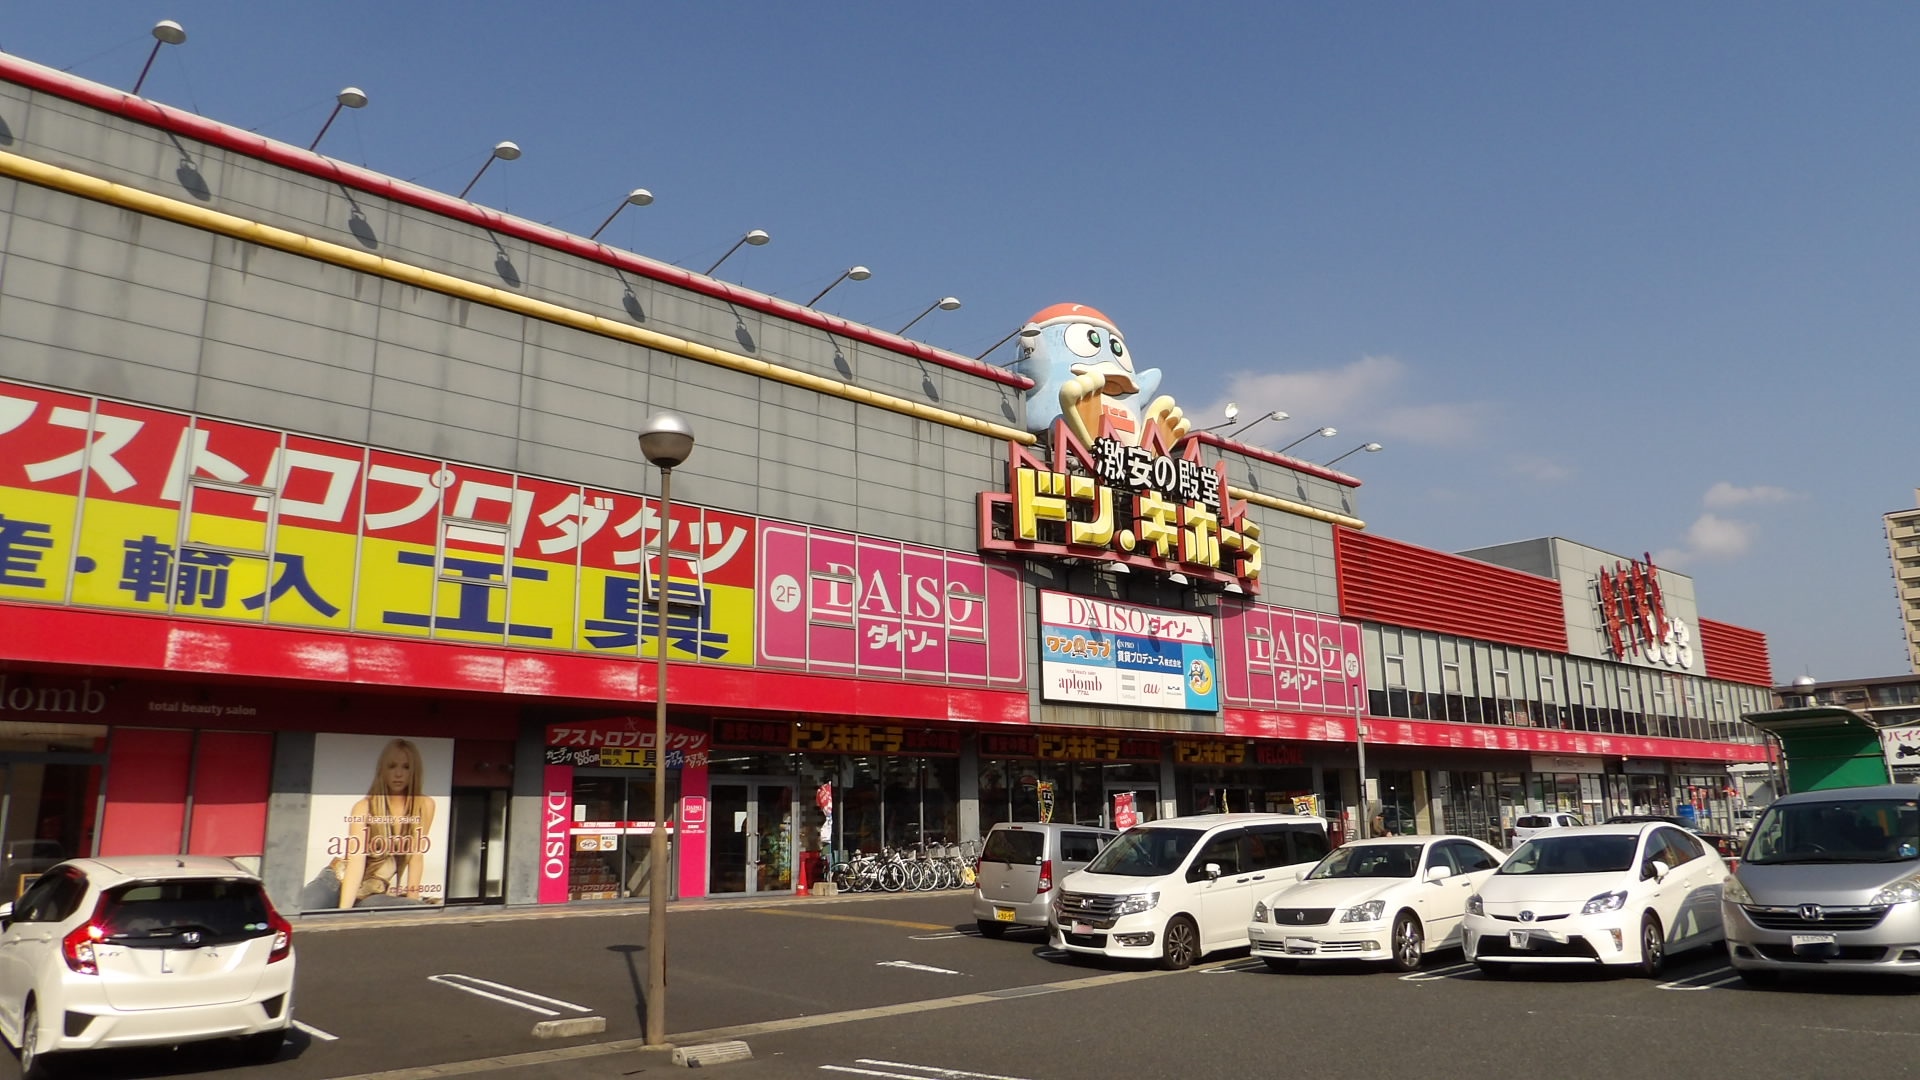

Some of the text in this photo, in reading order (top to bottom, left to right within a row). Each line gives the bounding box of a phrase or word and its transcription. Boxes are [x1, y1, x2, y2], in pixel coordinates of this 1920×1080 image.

[1096, 438, 1220, 508] 激安の殿堂
[776, 585, 798, 604] 2F
[826, 562, 973, 622] DAISO
[1067, 597, 1193, 638] DAISO ダイソー
[868, 624, 938, 653] ダイソー
[1254, 626, 1336, 667] DAISO
[1347, 659, 1357, 672] 2F
[1059, 674, 1102, 694] aplomb
[1279, 670, 1318, 691] ダイソー
[149, 701, 257, 717] total beauty salon
[574, 749, 591, 759] OUT
[577, 754, 601, 766] DOOR
[625, 749, 657, 766] 工具
[344, 815, 421, 824] total beauty salon
[327, 827, 431, 860] aplomb
[544, 790, 567, 879] DAISO
